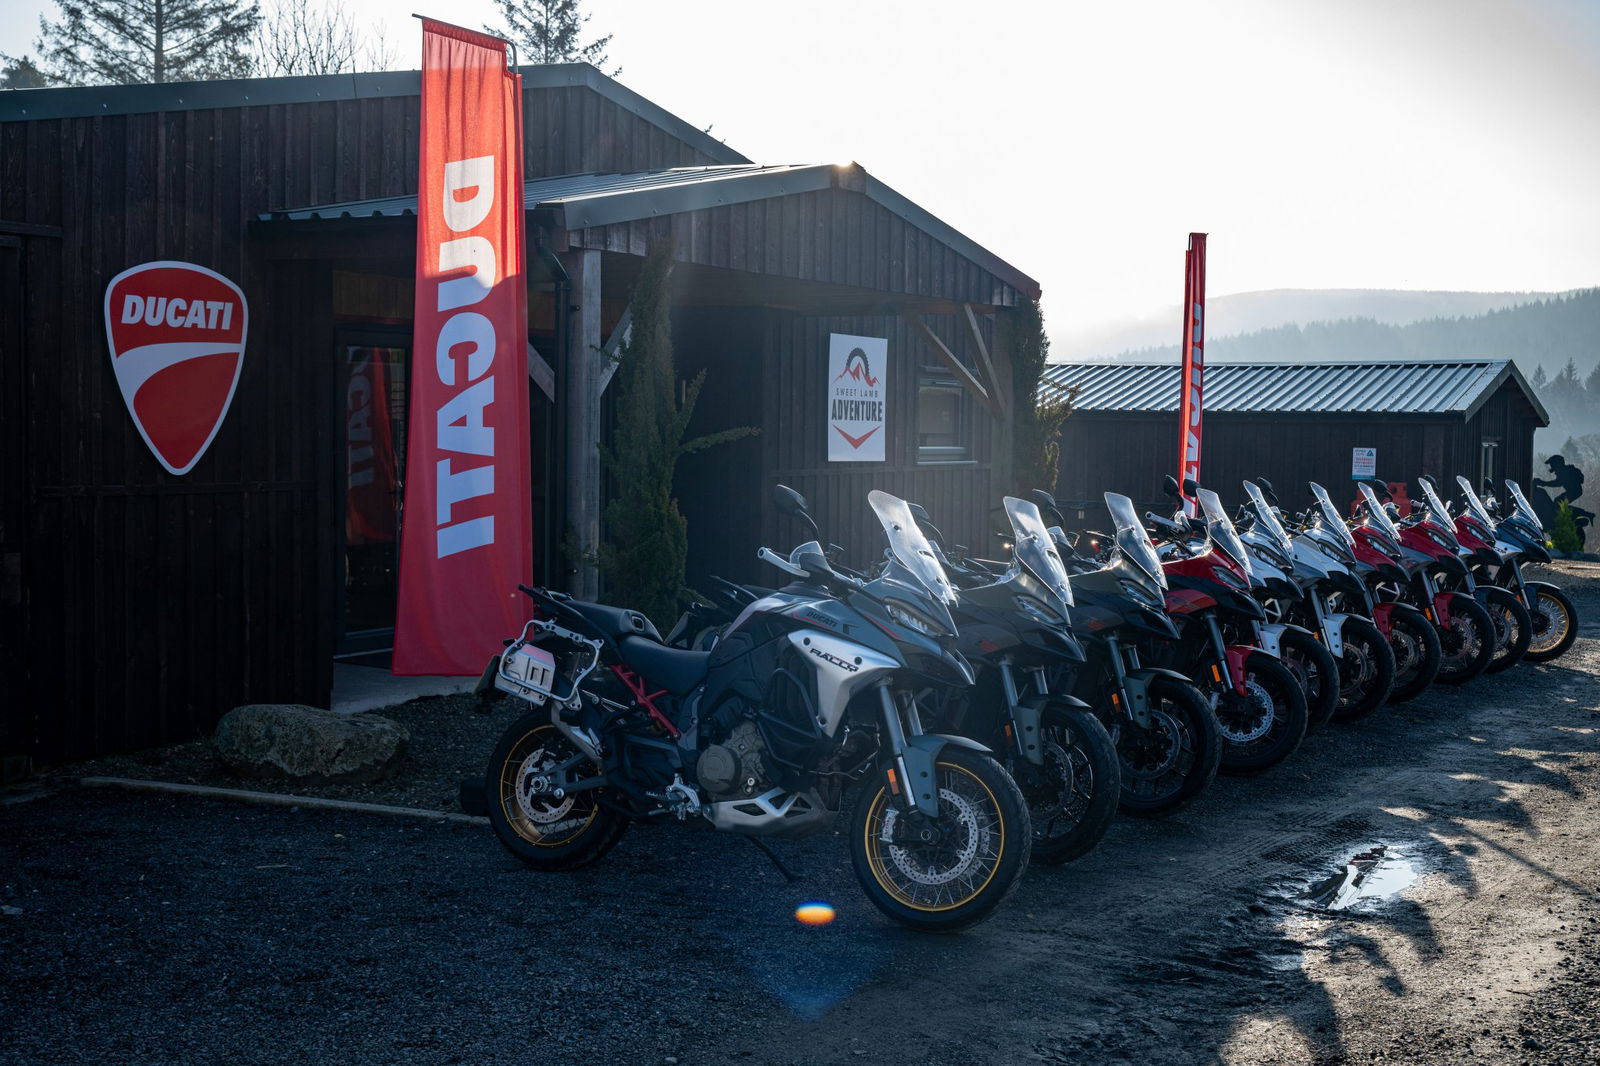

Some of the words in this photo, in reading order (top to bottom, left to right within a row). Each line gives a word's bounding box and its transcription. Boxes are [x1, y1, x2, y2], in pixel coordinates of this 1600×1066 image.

[121, 293, 234, 331] DUCATI
[836, 387, 857, 397] SWEET
[860, 389, 879, 398] LAMB
[831, 399, 883, 422] ADVENTURE
[807, 611, 839, 628] DUCATI
